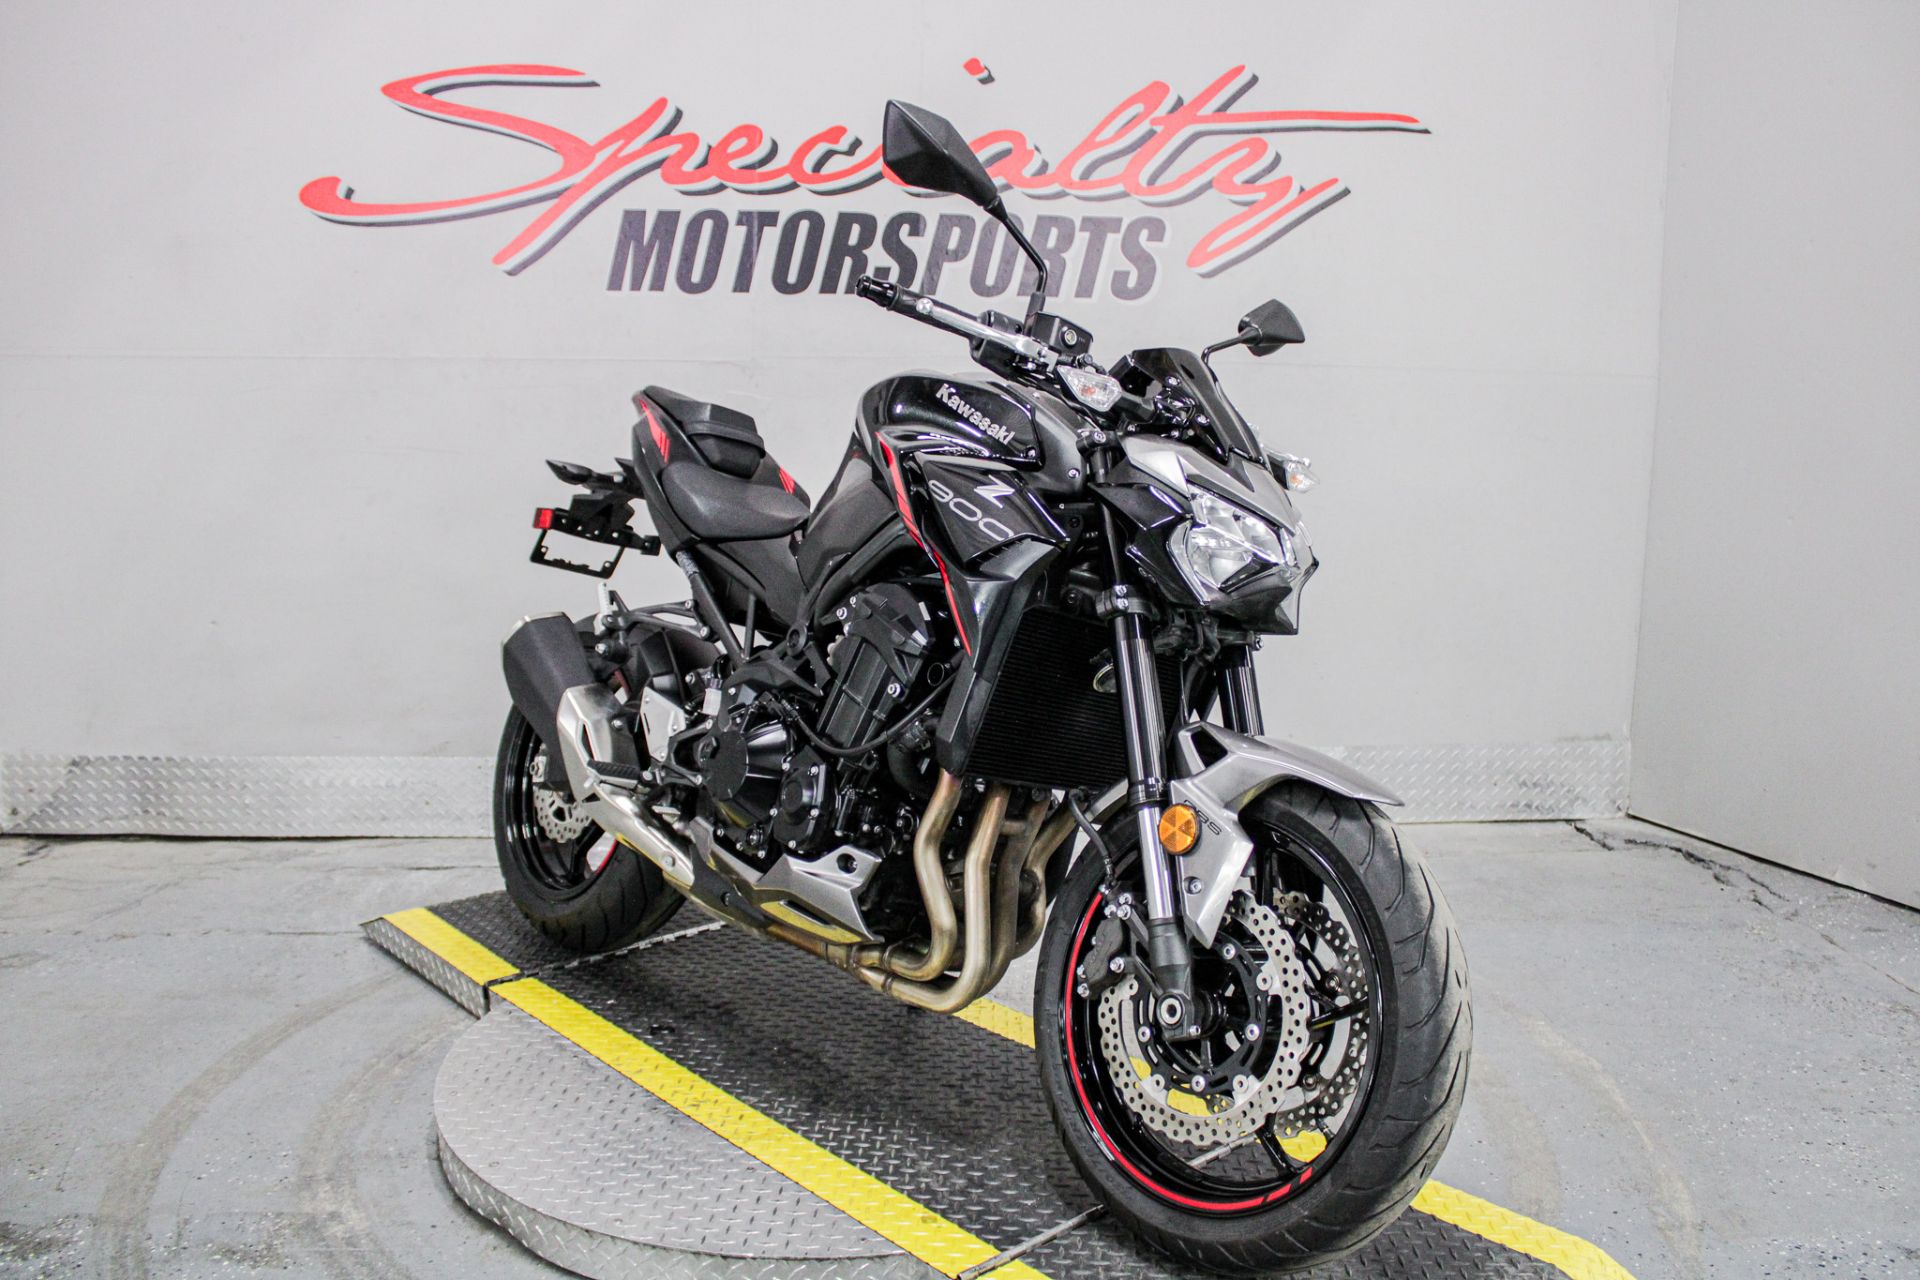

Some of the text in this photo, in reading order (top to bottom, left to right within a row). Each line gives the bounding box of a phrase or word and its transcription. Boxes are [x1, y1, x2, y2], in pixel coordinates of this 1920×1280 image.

[299, 57, 1431, 278] Specalty
[606, 208, 1166, 301] MOTORSPORTS
[935, 383, 1015, 444] Kawasaki
[928, 479, 1014, 541] 900
[974, 474, 1015, 509] Z
[1183, 799, 1222, 835] BS
